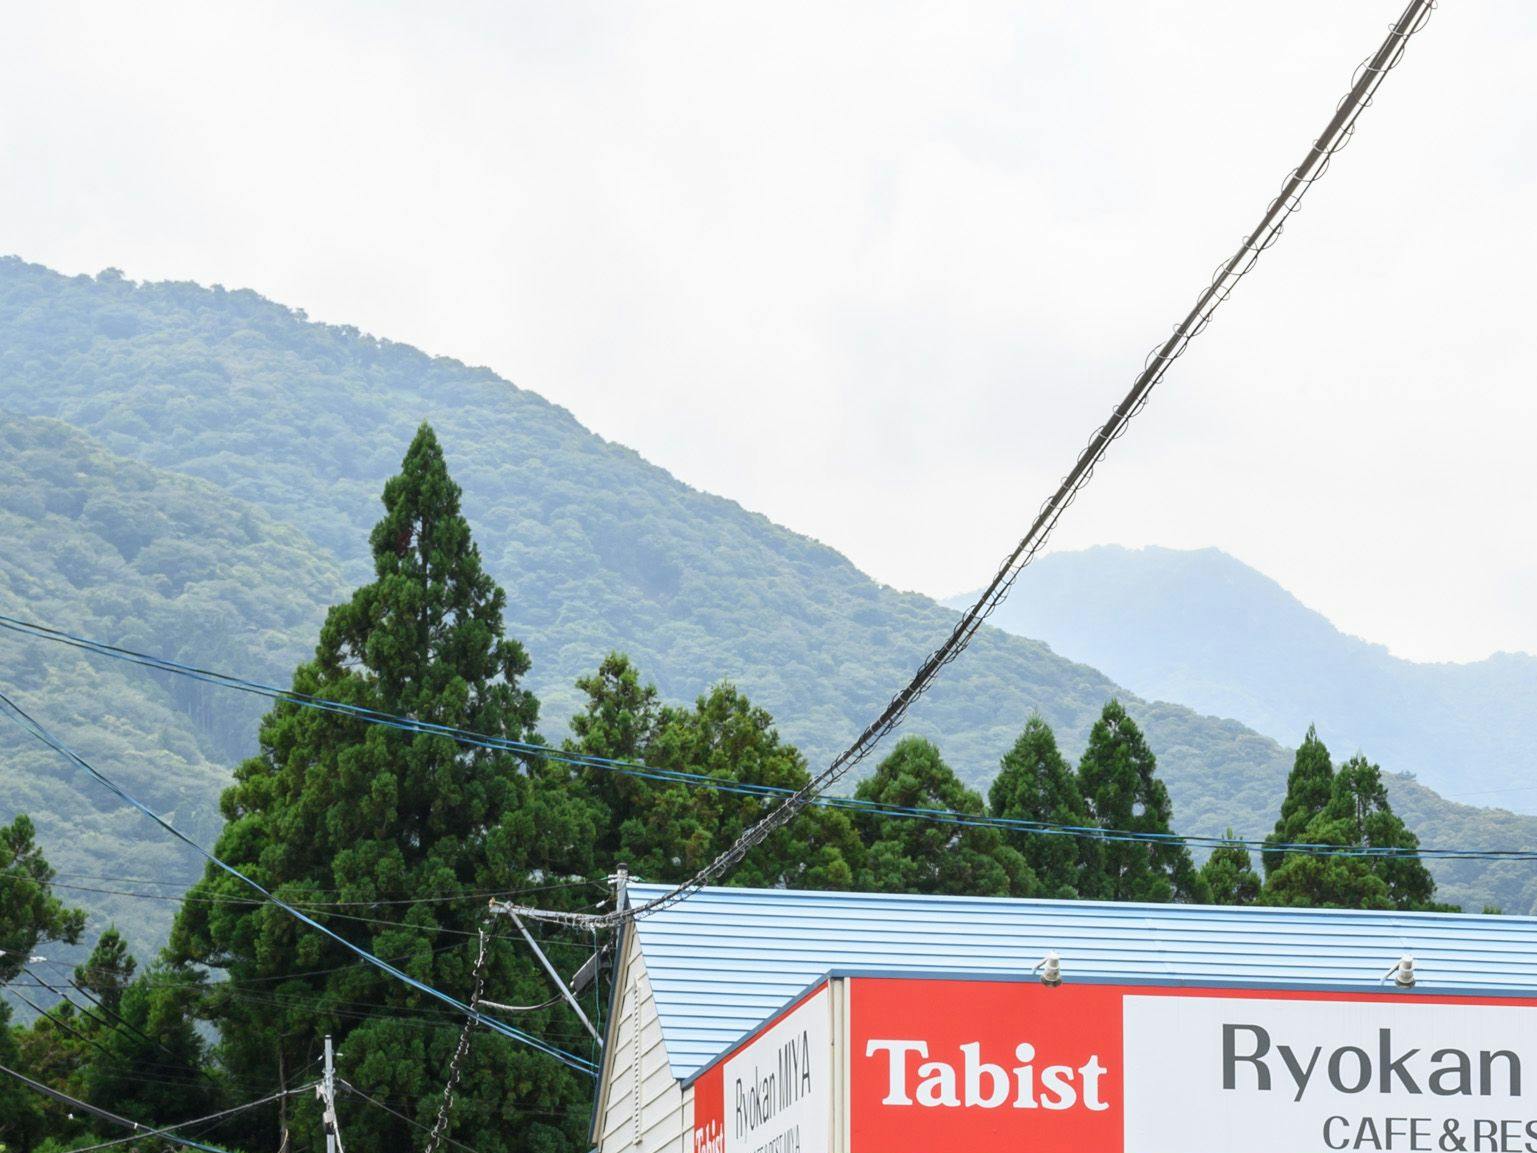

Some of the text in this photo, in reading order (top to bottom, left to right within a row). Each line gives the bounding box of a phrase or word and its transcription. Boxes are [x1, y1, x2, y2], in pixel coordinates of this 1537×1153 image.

[736, 1030, 811, 1143] Ryokan MIYA
[865, 1039, 1110, 1112] Tabist
[1222, 1023, 1522, 1102] Ryokan
